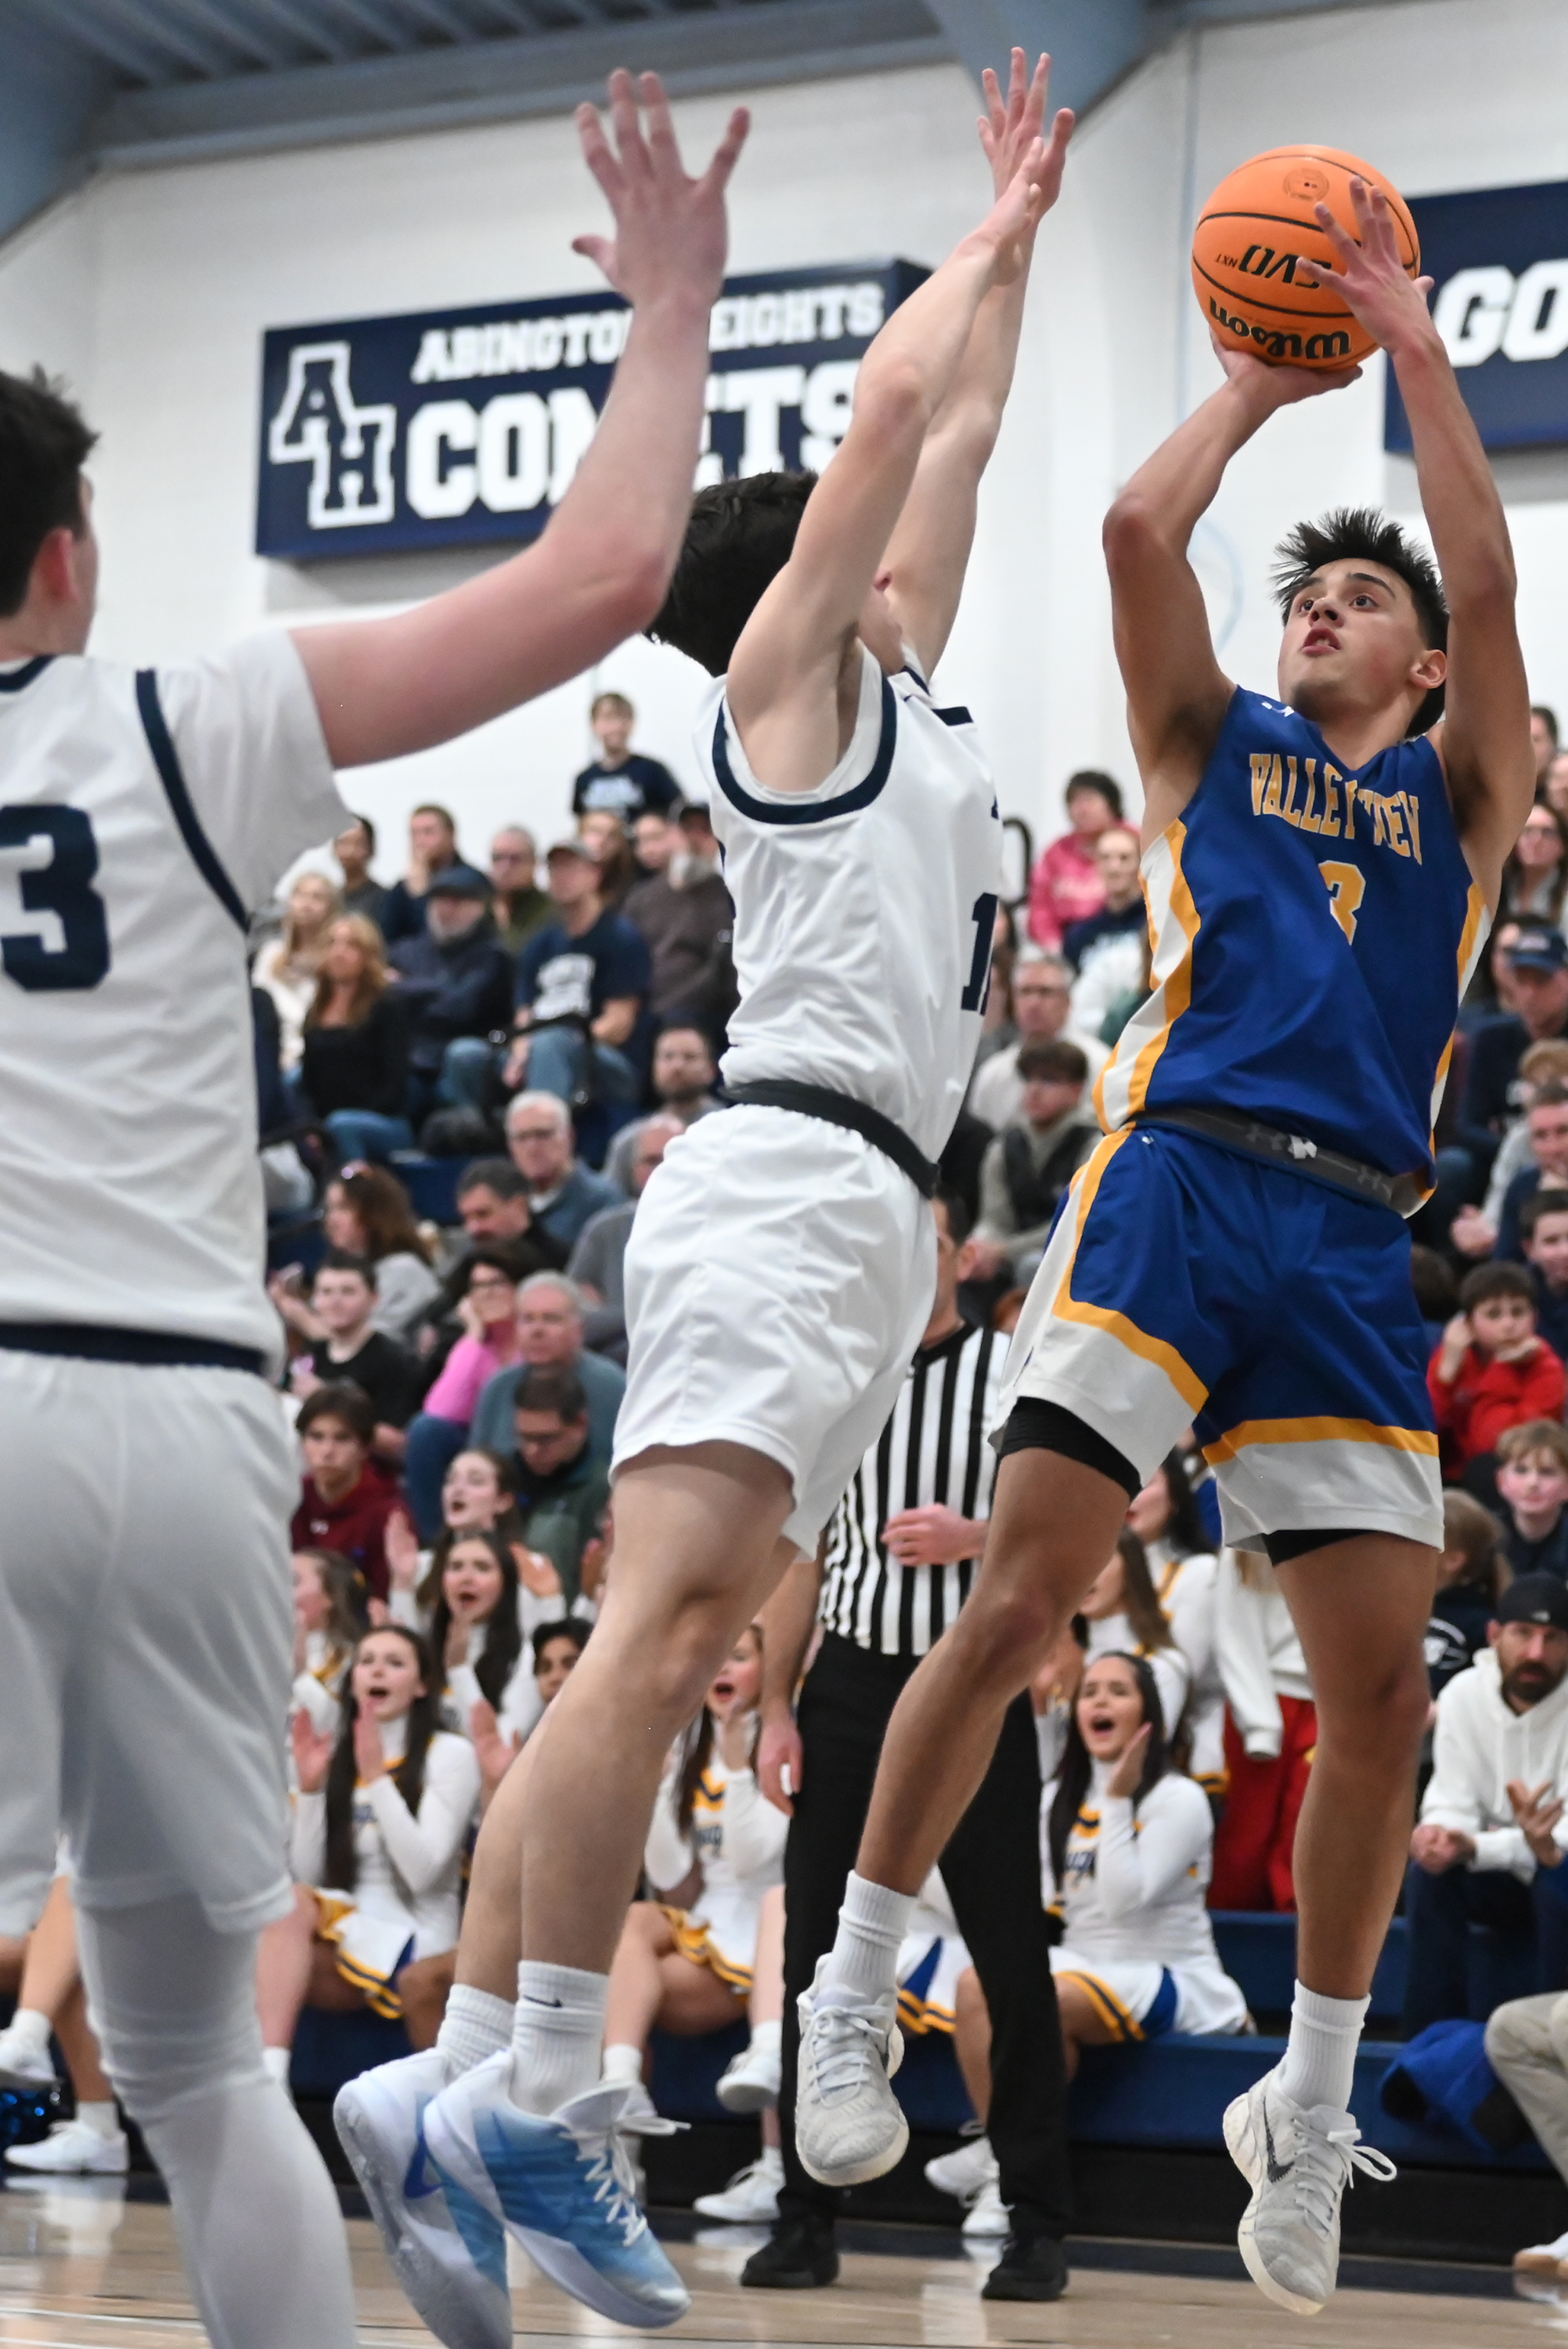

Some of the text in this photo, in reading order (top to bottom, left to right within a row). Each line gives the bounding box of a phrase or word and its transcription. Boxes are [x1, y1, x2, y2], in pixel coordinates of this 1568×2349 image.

[409, 282, 885, 384] ABINGTO EIGHTS
[1209, 295, 1352, 360] Wilson
[1317, 859, 1367, 946] 3
